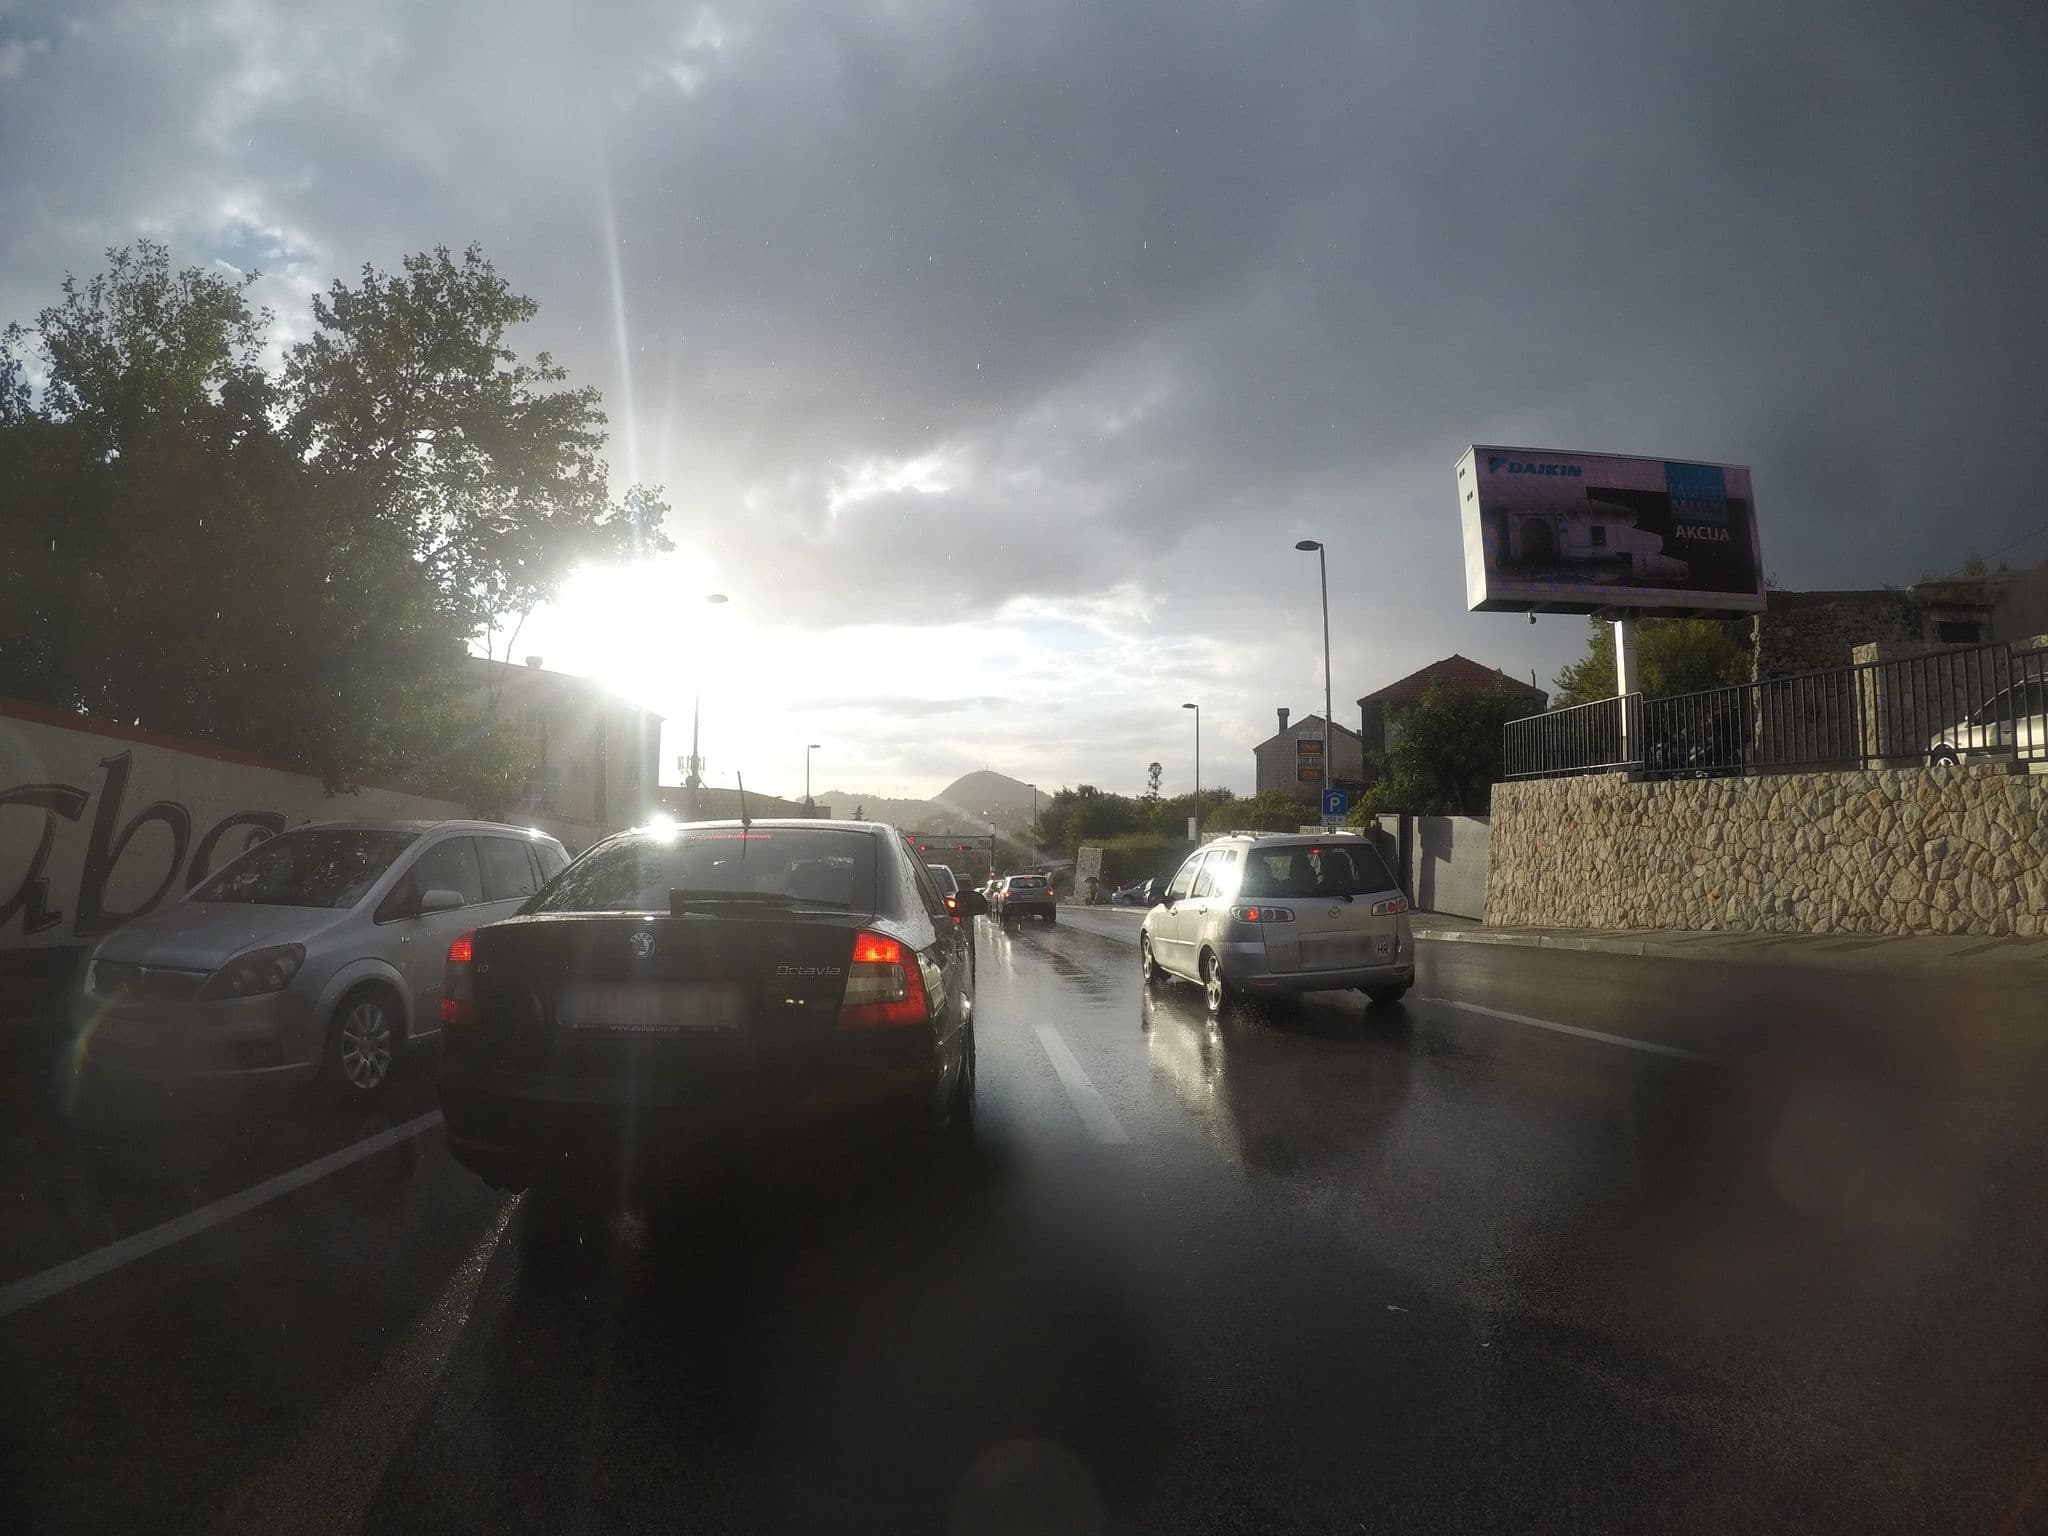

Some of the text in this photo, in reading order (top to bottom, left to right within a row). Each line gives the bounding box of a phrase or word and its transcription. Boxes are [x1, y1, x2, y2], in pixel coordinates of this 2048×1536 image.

[1508, 462, 1582, 477] DAIKIN
[1675, 525, 1730, 542] AKCIJA
[1330, 797, 1341, 812] P
[1377, 943, 1389, 955] HR
[777, 964, 842, 976] Octavia
